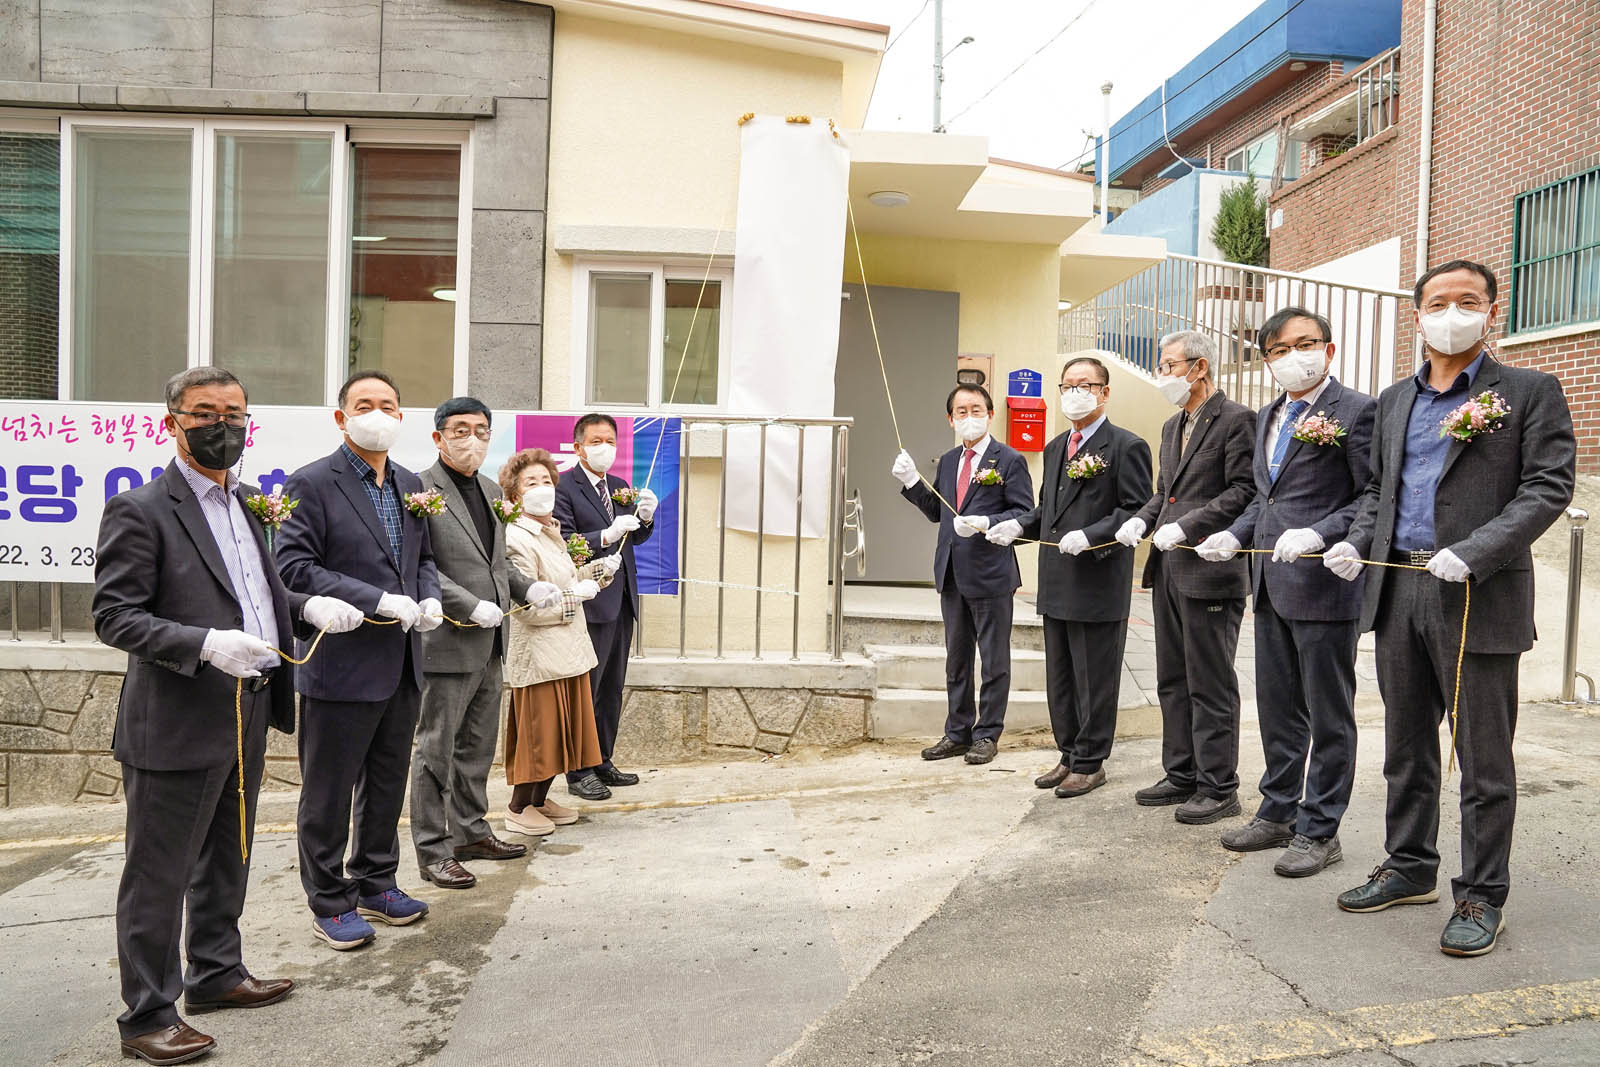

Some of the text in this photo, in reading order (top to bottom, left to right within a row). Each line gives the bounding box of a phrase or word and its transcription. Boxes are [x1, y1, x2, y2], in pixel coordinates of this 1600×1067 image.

[1021, 382, 1029, 394] 7
[2, 413, 168, 452] 넘치는 행복한
[0, 464, 84, 523] 당
[40, 546, 59, 567] 3.
